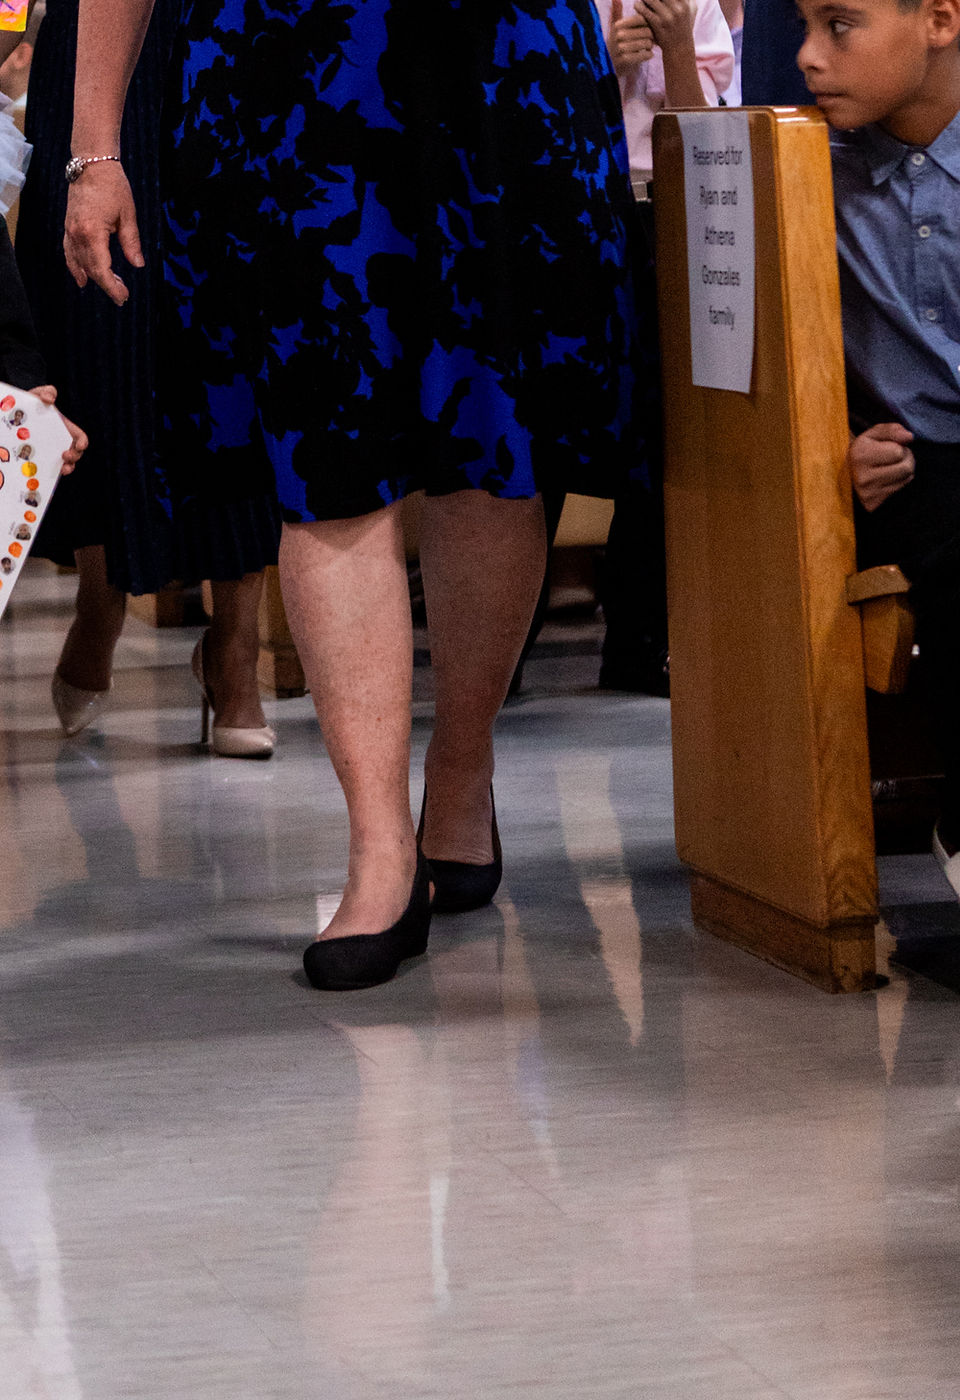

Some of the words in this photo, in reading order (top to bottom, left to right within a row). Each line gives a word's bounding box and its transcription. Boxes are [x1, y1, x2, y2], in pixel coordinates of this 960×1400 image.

[693, 146, 730, 166] Reserved
[730, 146, 743, 165] for
[700, 186, 719, 209] Ryan
[721, 186, 738, 205] and
[704, 226, 735, 245] Athena
[708, 305, 736, 330] family
